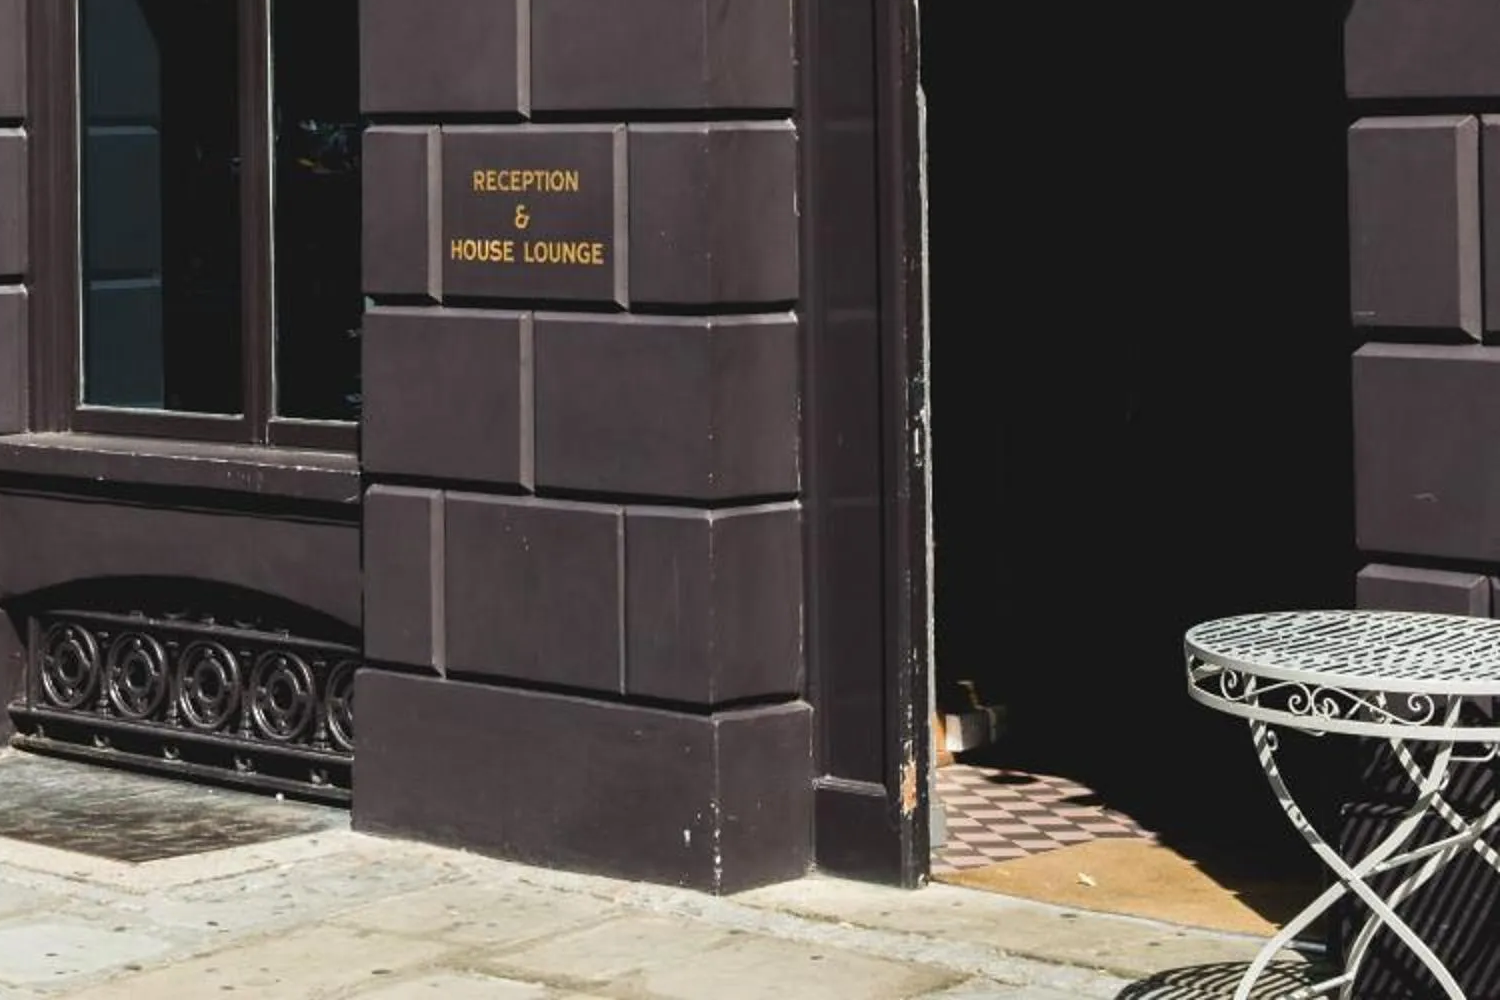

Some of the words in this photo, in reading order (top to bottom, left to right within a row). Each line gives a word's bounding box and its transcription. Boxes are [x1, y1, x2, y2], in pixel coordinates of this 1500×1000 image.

[472, 170, 579, 192] RECEPTION
[514, 204, 530, 229] &
[451, 239, 515, 263] HOUSE
[524, 241, 605, 265] LOUNGE
